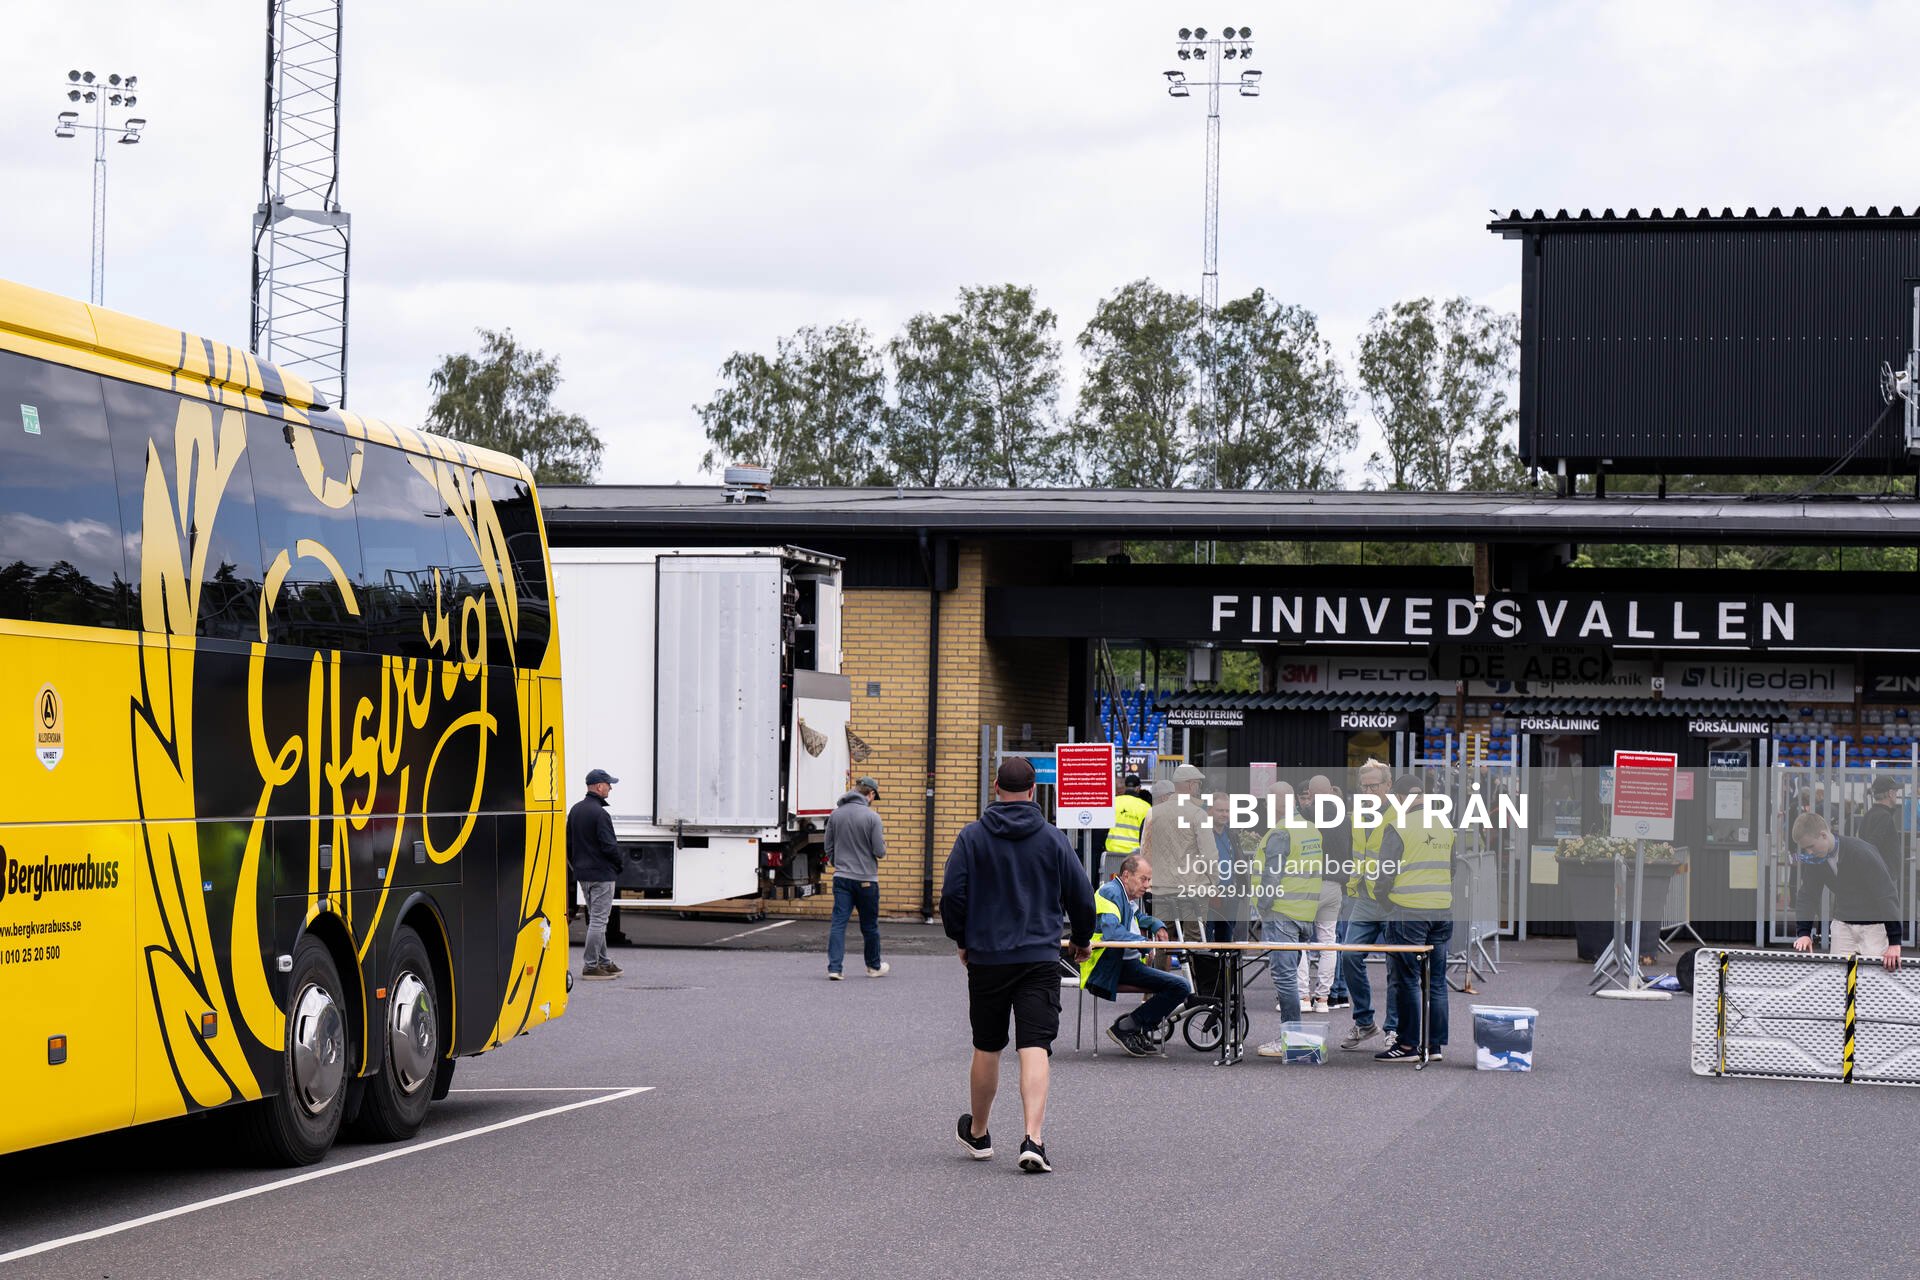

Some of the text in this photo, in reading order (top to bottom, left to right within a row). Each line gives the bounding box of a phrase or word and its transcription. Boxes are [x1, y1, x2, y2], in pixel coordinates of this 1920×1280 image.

[1211, 595, 1795, 641] FINNVEDSVALLEN
[1282, 664, 1318, 684] 3M
[1711, 666, 1836, 694] Liljedahl
[1653, 678, 1662, 689] G
[1168, 709, 1244, 720] ACKREDITERING
[1340, 712, 1398, 728] FÖRKÖP
[1520, 716, 1600, 731] FÖRSÄLJNING
[1688, 718, 1770, 734] FÖRSÄLJNING
[8, 853, 119, 901] Bergkvarabuss
[5, 949, 20, 965] 010
[22, 948, 32, 963] 25
[34, 946, 44, 962] 20
[46, 945, 60, 960] 500
